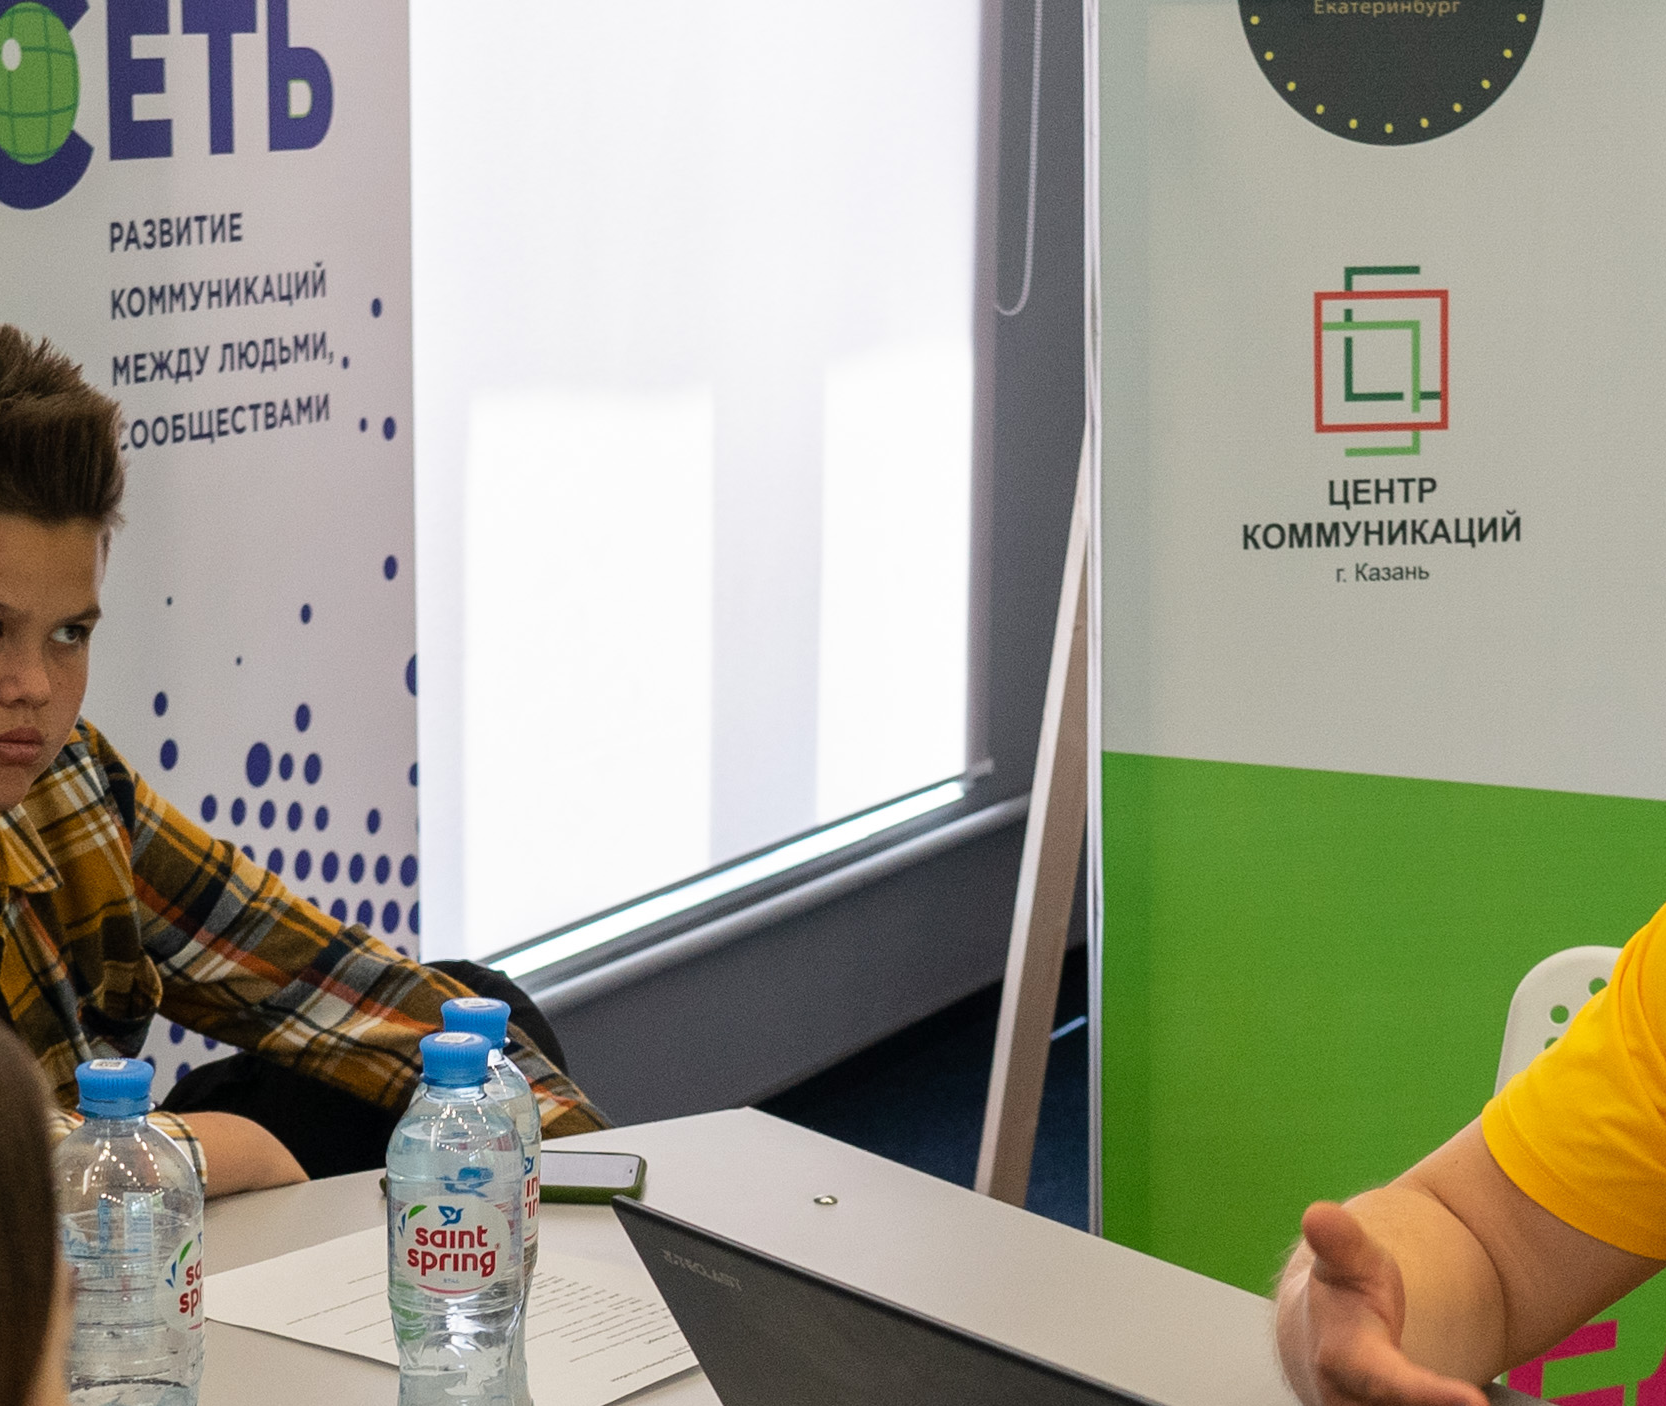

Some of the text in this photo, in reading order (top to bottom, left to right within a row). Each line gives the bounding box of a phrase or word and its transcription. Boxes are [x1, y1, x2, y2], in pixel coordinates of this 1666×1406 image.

[109, 212, 243, 253] РАЗВИТИЕ
[111, 262, 327, 320] КОММУНИКАЦИЙ
[112, 331, 334, 387] МЕЖДУ ЛЮДЬМИ,
[1328, 477, 1437, 510] ЦЕНТР
[1242, 510, 1522, 550] КОММУНИКАЦИЙ
[1355, 563, 1430, 583] Казань
[415, 1225, 488, 1249] saint
[407, 1248, 496, 1277] spring
